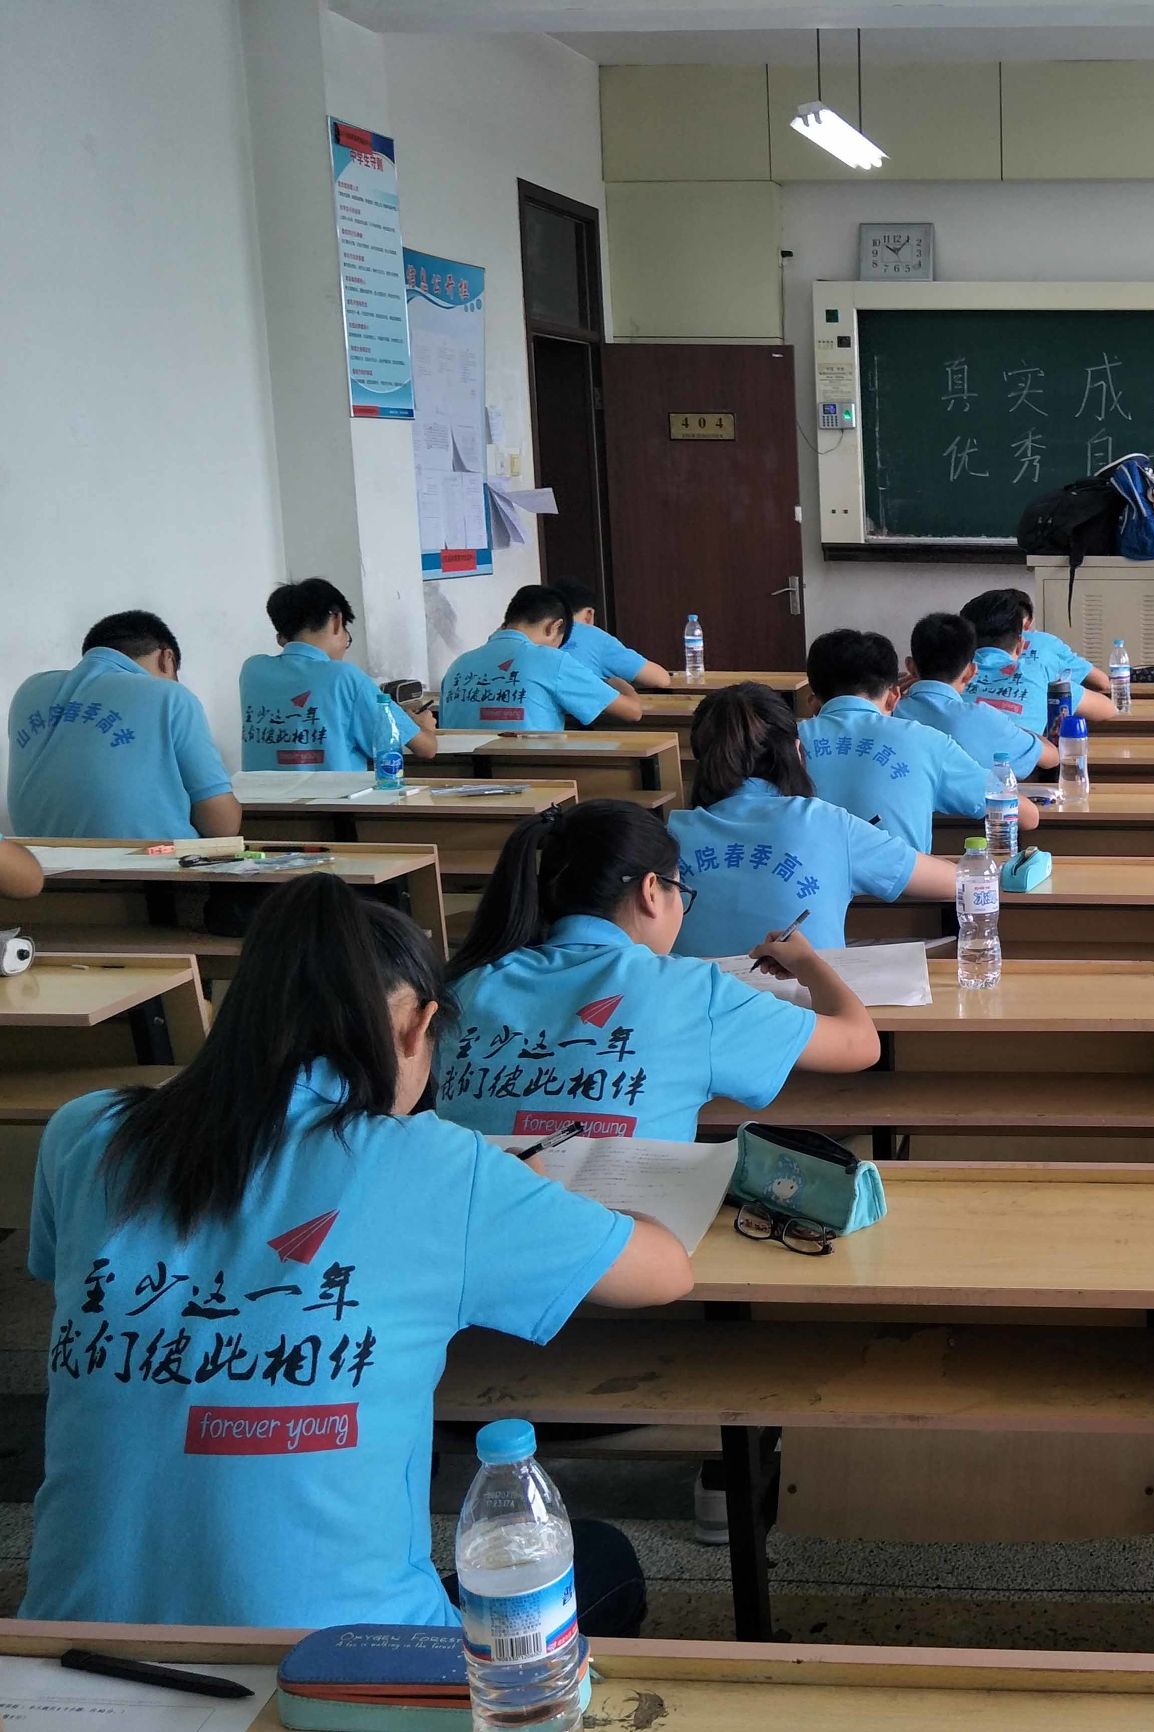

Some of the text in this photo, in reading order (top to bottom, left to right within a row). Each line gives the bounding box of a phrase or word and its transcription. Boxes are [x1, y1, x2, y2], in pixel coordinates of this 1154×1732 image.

[681, 416, 724, 429] 404
[456, 1025, 637, 1062] 至少这一年
[441, 1062, 647, 1106] 我们彼此相伴
[521, 1114, 580, 1135] foreve
[81, 1257, 360, 1321] 至少这一年
[51, 1319, 377, 1388] 我们彼此相伴
[199, 1411, 350, 1451] forever young
